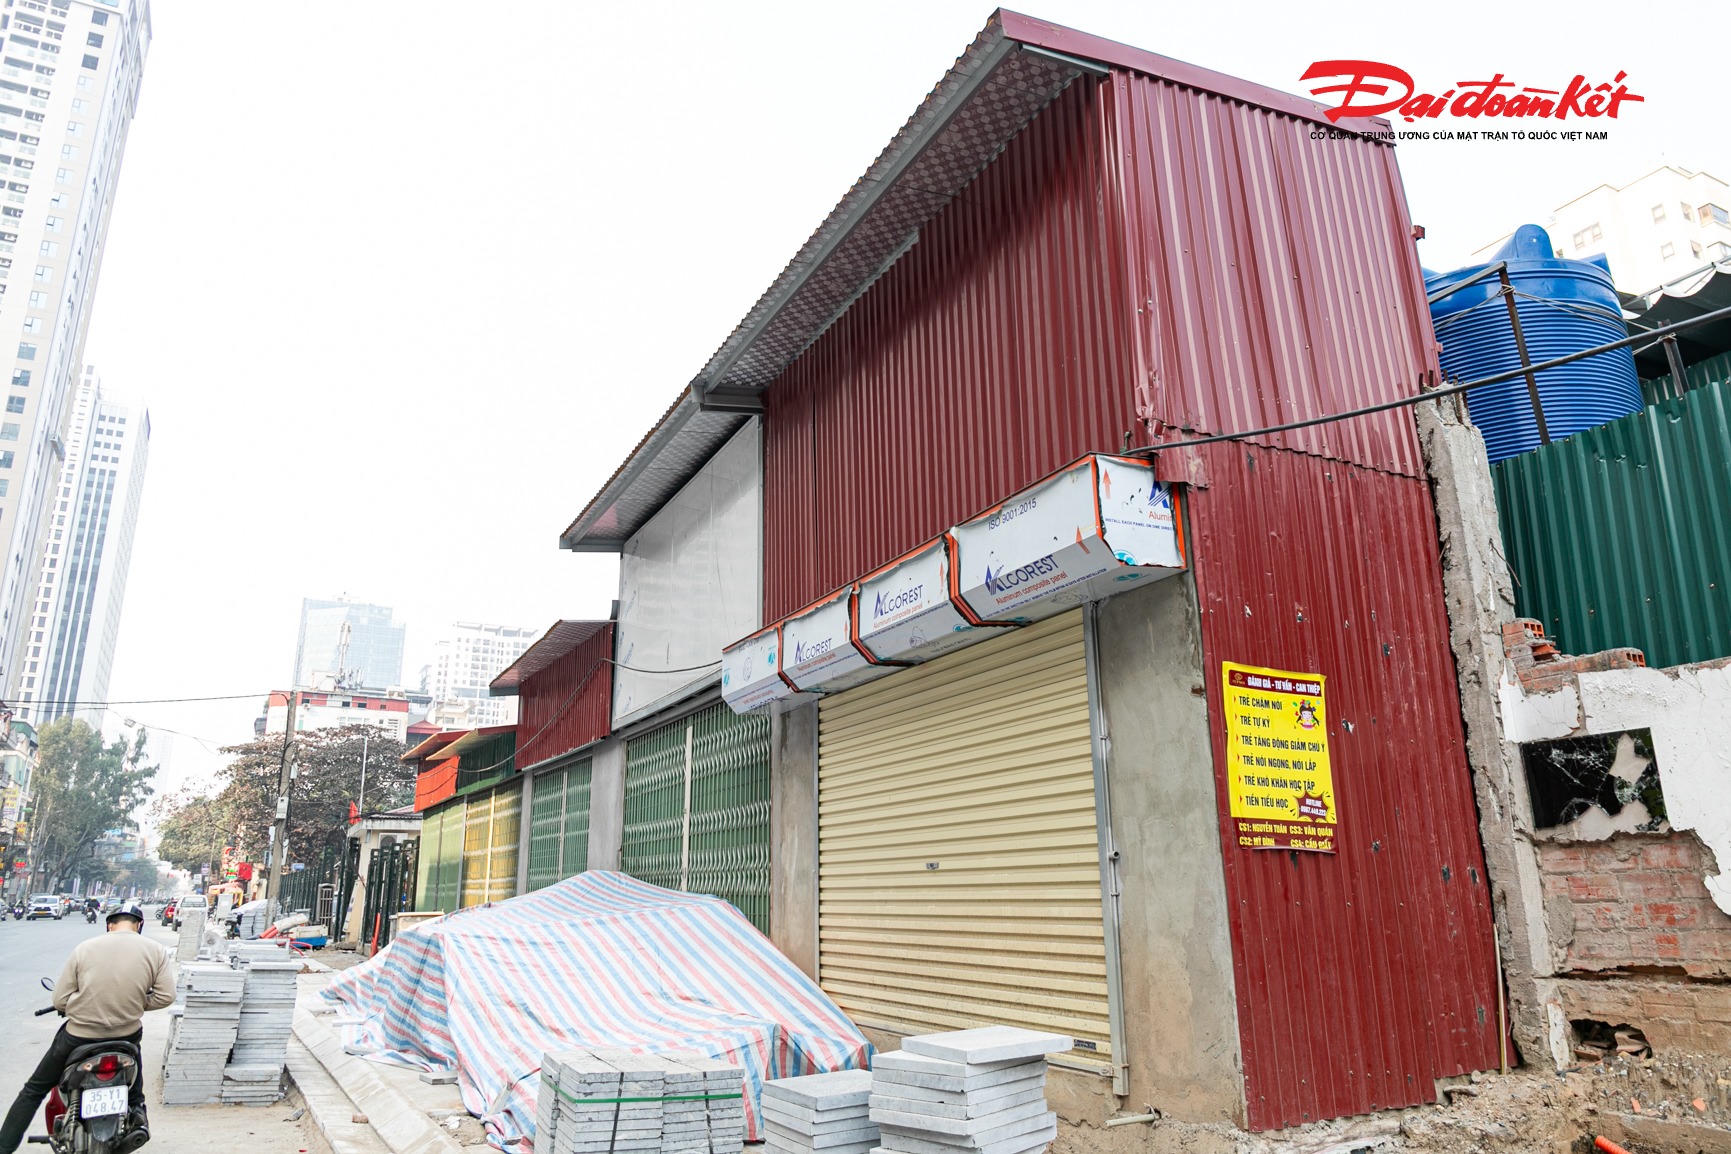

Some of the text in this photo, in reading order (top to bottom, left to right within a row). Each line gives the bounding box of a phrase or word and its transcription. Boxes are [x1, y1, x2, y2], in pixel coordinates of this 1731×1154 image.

[988, 497, 1037, 531] ISO 9001:2015
[985, 554, 1059, 595] ALCOREST
[996, 589, 1022, 605] Aluminum
[1022, 578, 1051, 595] composite
[1051, 570, 1068, 585] panel
[874, 584, 923, 619] ALCOREST
[794, 637, 832, 664] ALCOREST
[1275, 798, 1289, 810] HỌC
[1239, 822, 1252, 832] CS1:
[85, 1099, 124, 1115] 048.47
[90, 1088, 120, 1102] 35-Y1
